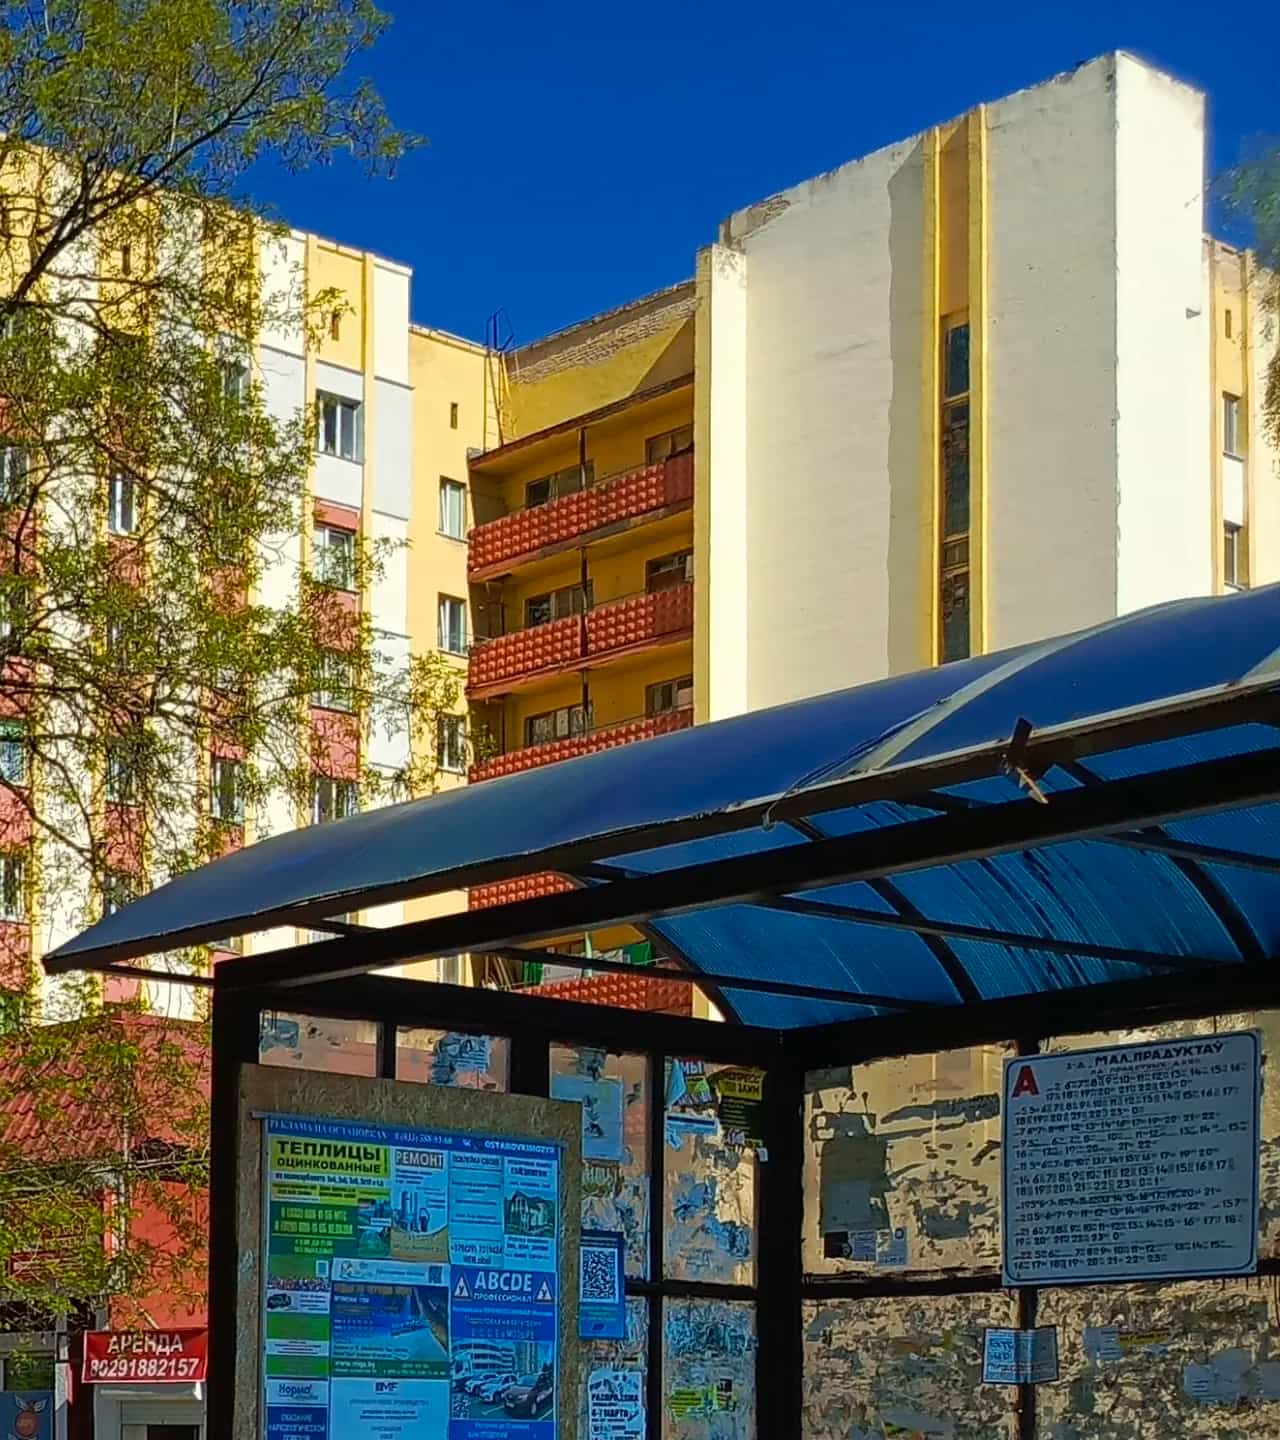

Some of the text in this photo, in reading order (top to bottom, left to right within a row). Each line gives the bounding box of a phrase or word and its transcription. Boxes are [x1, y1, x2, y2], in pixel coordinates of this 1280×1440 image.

[277, 1141, 381, 1161] ТЕПЛИЦЫ
[396, 1151, 443, 1167] РЕМОНТ
[277, 1158, 381, 1174] ОЦИНКОВАННЫЕ
[474, 1271, 533, 1292] ABCDE
[107, 1334, 184, 1356] АРЕНДА
[90, 1357, 199, 1379] 80291882157
